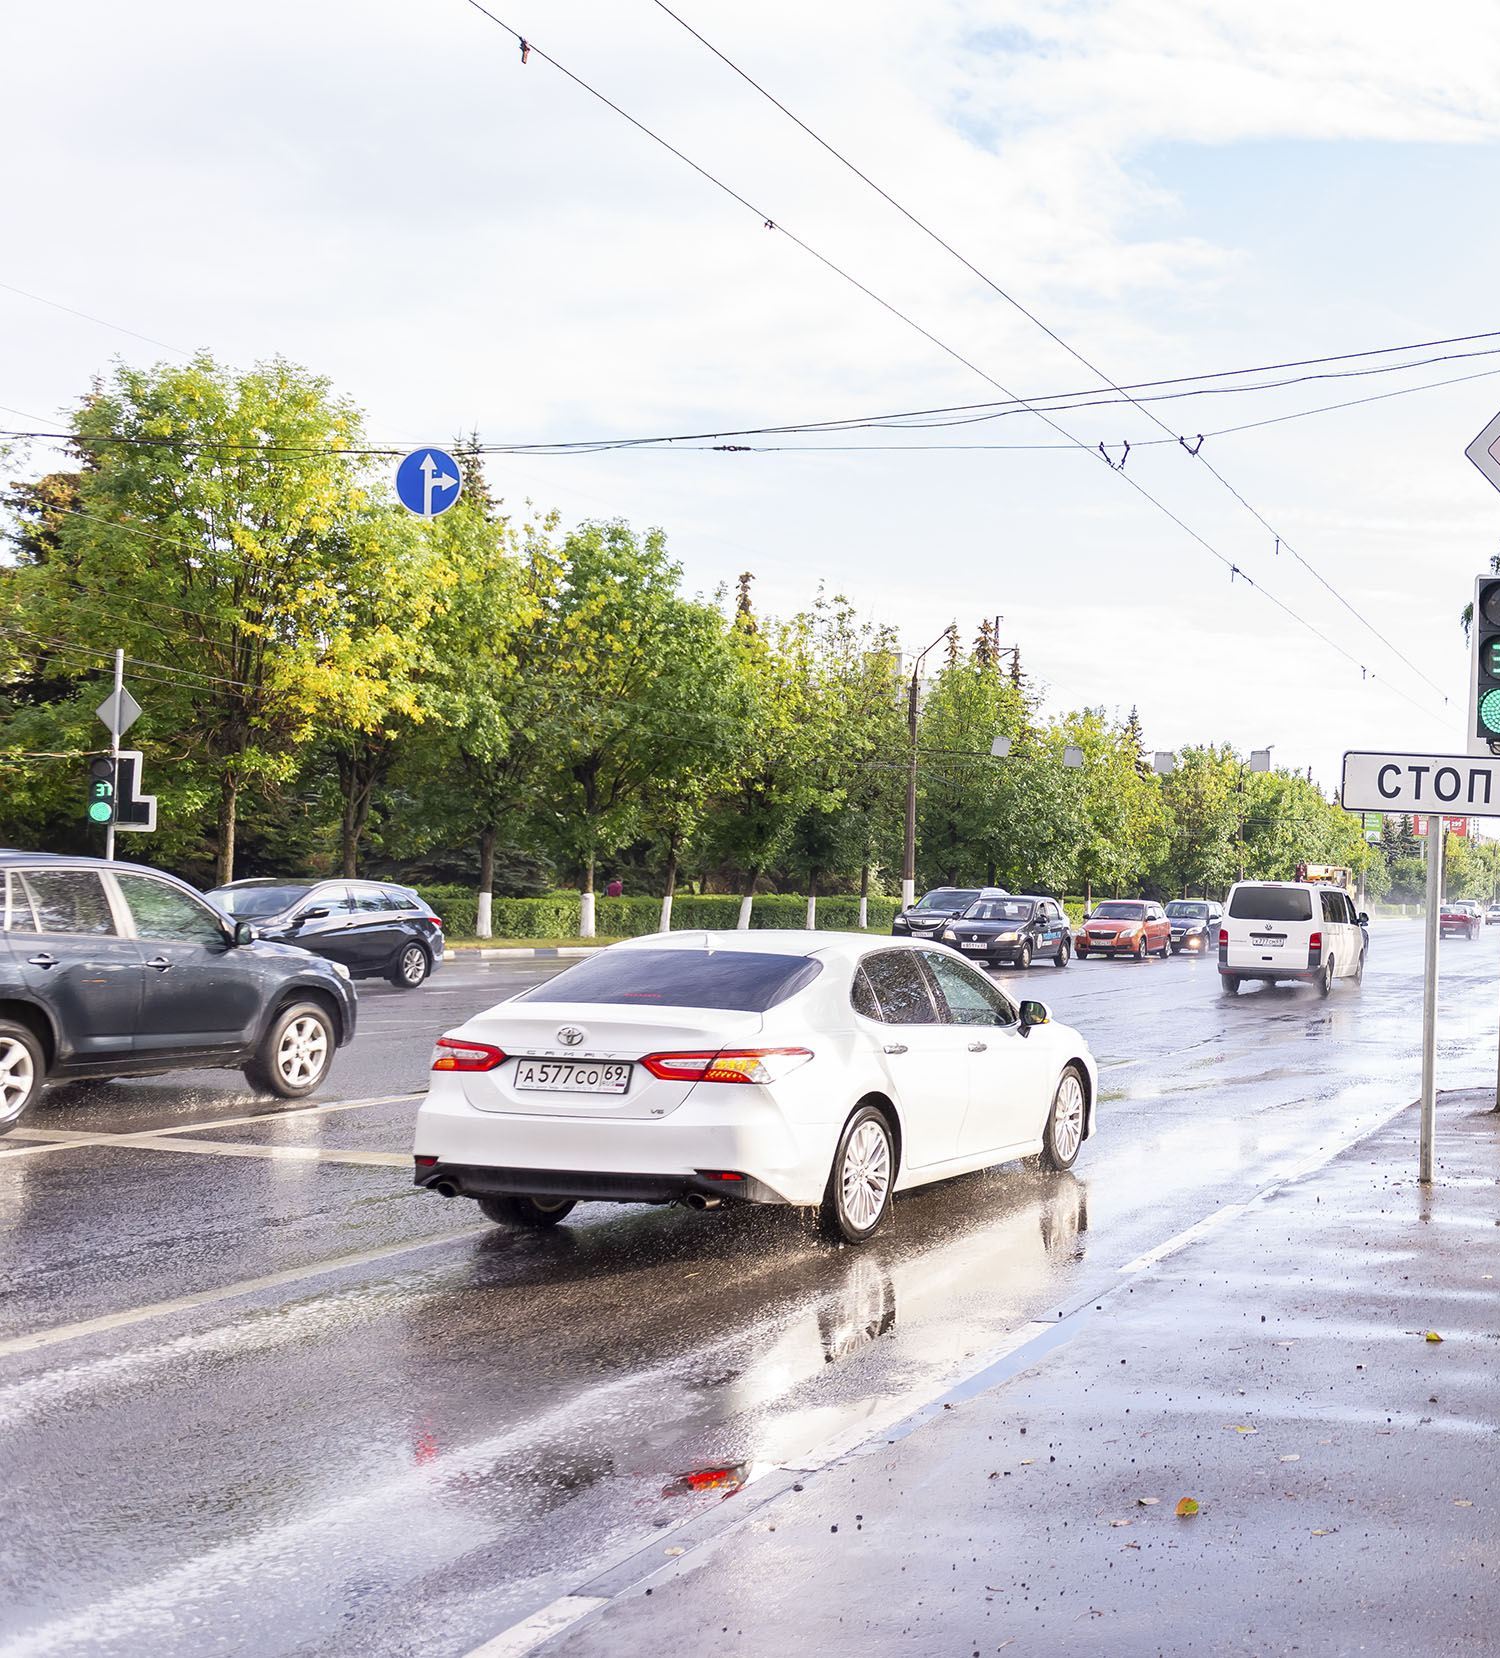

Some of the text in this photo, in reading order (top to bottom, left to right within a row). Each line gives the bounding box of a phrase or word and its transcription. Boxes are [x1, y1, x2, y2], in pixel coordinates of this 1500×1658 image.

[95, 783, 112, 797] 37
[1377, 763, 1493, 804] СТОП
[526, 1049, 616, 1059] CAMRY
[604, 1066, 623, 1081] 69
